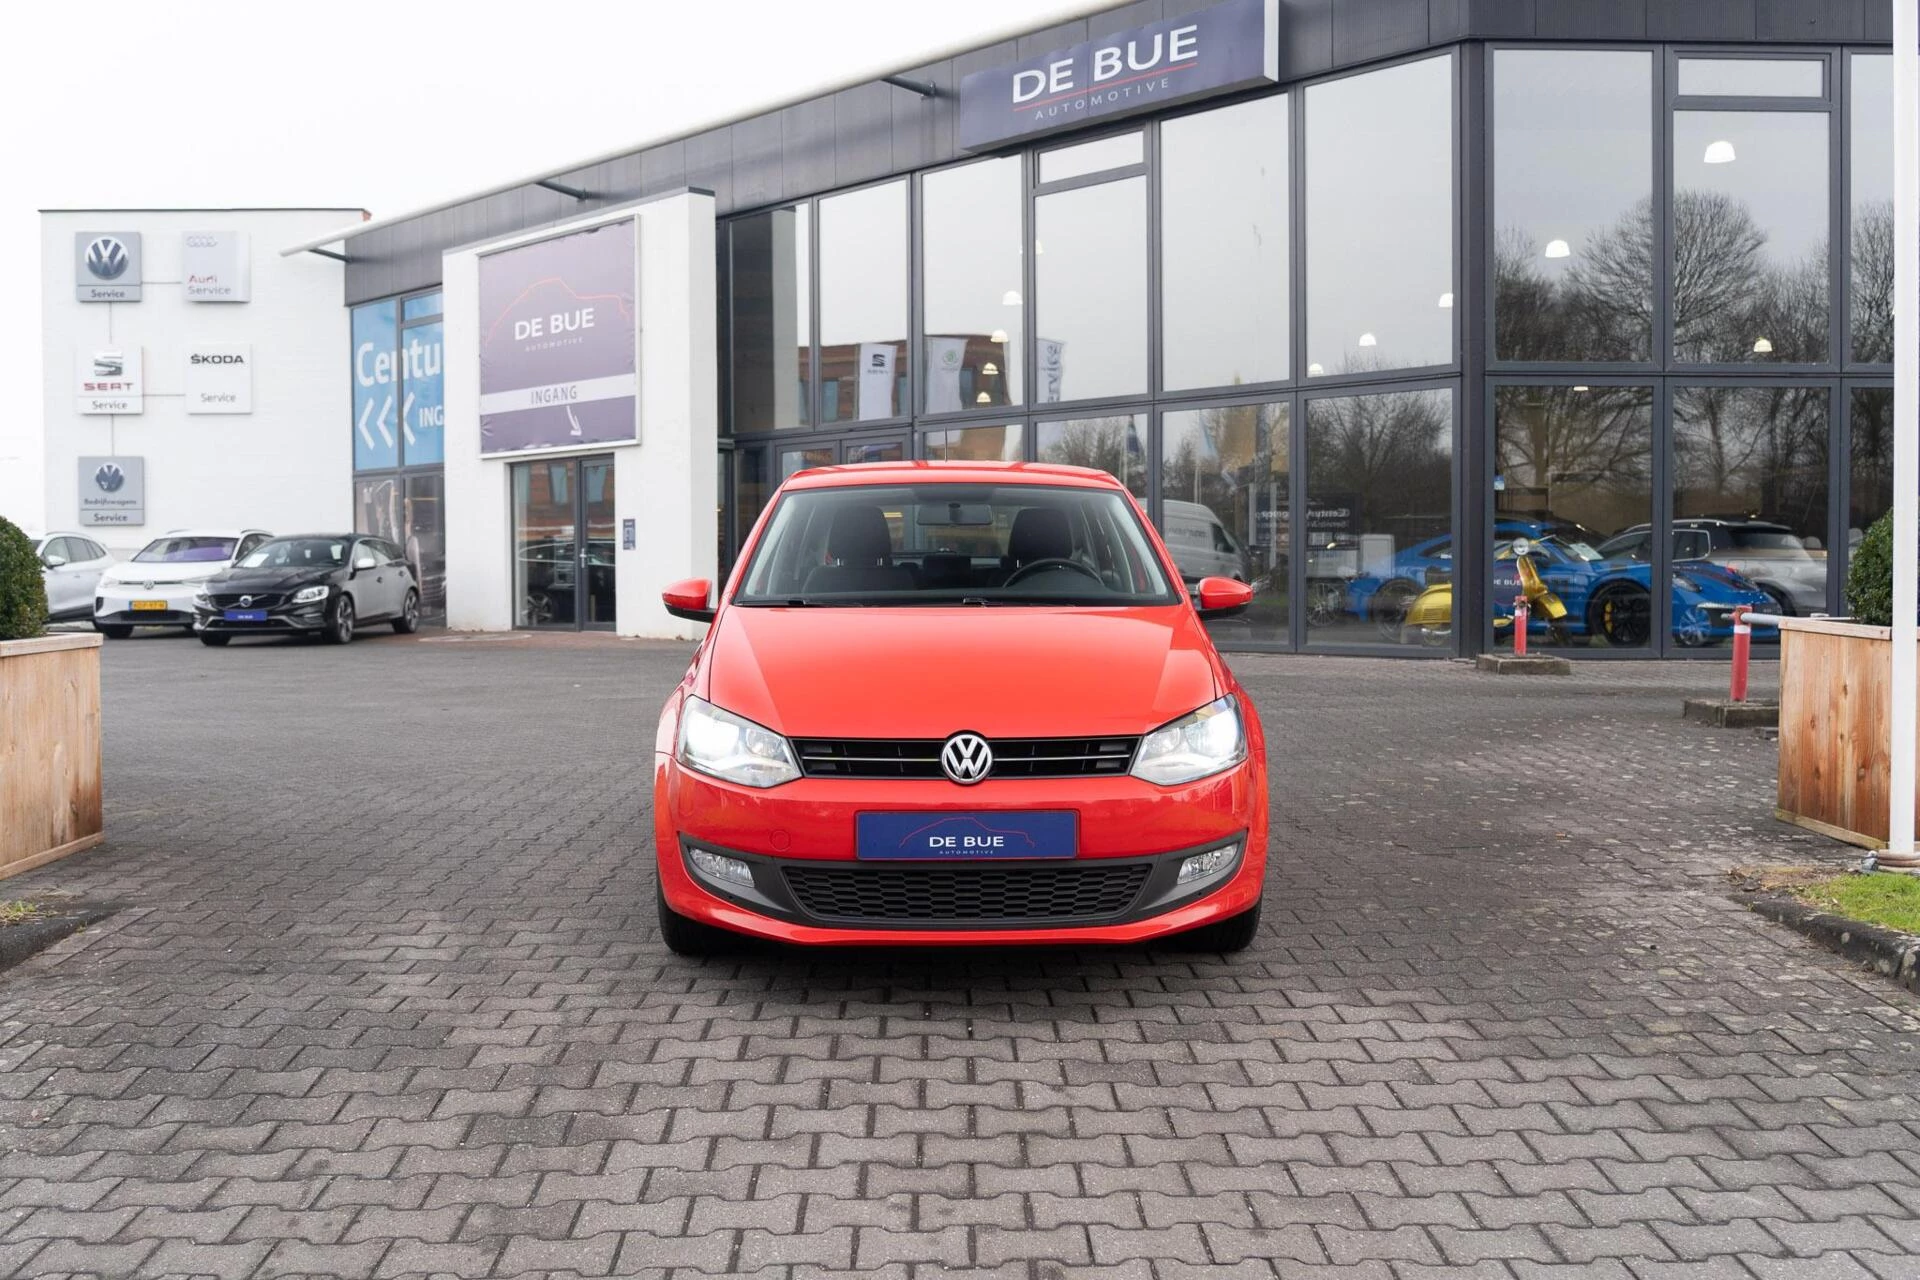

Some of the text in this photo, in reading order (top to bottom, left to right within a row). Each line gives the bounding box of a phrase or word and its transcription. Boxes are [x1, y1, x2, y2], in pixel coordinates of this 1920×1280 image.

[1012, 24, 1199, 104] DE BUE
[1034, 77, 1169, 121] AUTOMOTIVE
[91, 288, 125, 298] Service
[188, 286, 231, 295] Service
[514, 307, 595, 341] DE BUE
[525, 336, 583, 352] AUTOMOTIVE
[190, 353, 244, 365] ŠKODA
[83, 382, 134, 391] SEAT
[201, 393, 236, 403] Service
[530, 385, 577, 404] INGANG
[92, 400, 128, 410] Service
[93, 513, 128, 522] Service
[929, 836, 1005, 848] DE BUE
